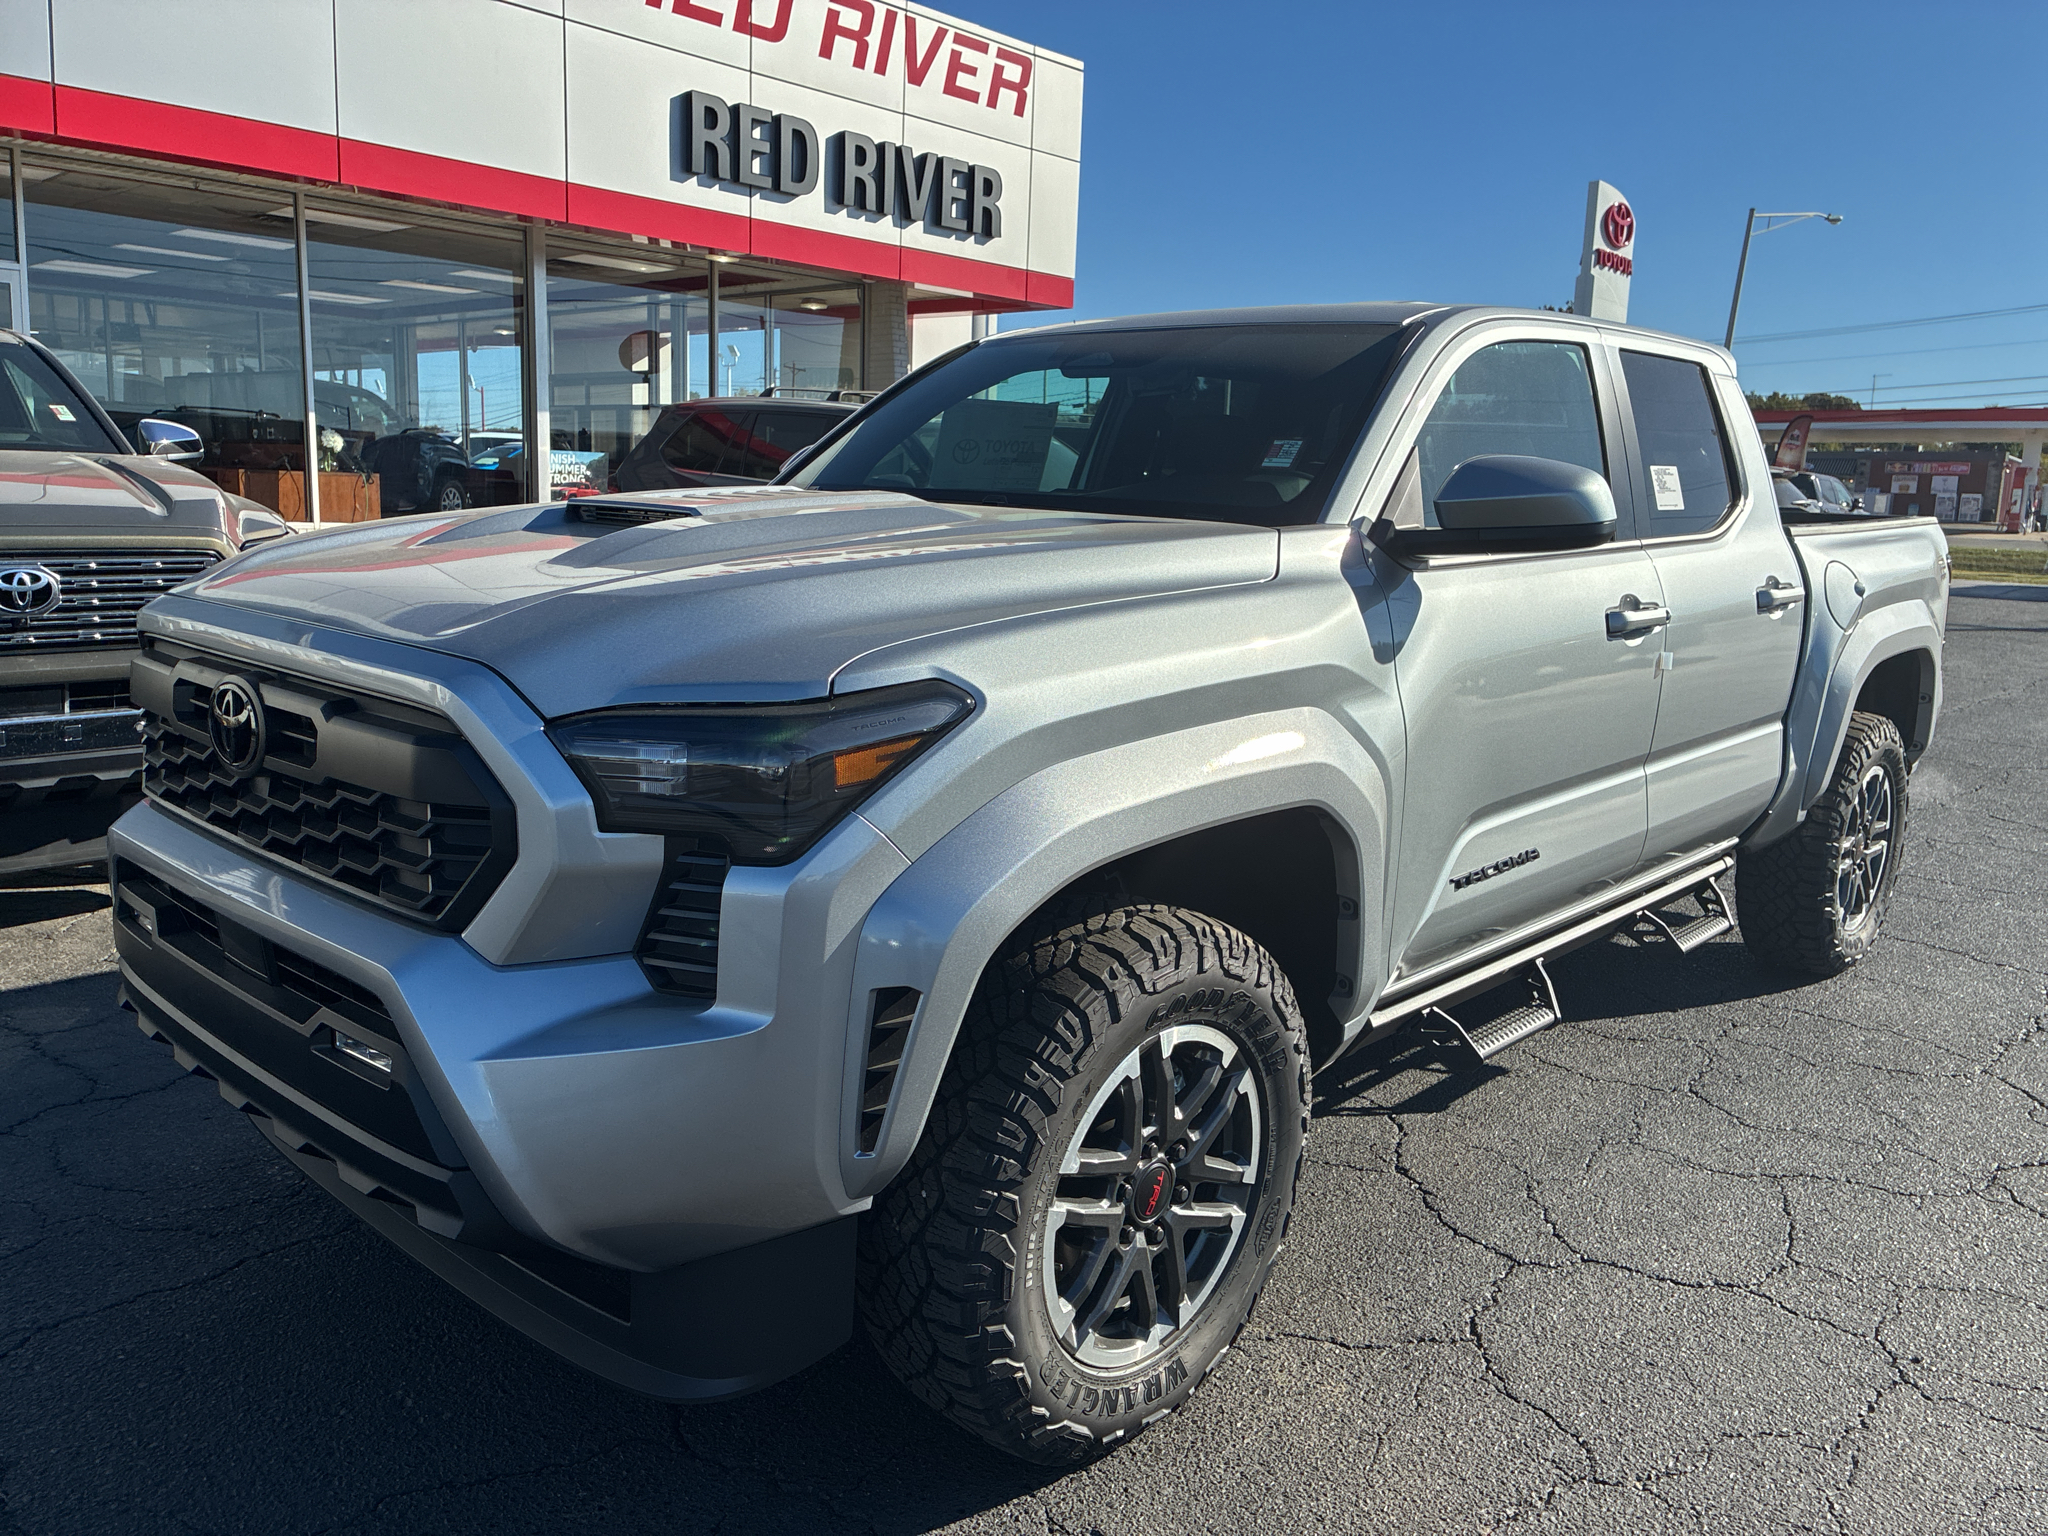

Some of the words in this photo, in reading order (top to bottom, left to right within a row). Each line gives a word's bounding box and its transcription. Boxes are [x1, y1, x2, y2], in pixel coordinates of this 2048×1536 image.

[818, 0, 1033, 118] RIVER
[684, 90, 819, 197] RED
[836, 130, 1002, 238] RIVER
[1596, 248, 1632, 276] TOYOTA
[550, 453, 576, 464] NISH
[985, 438, 1035, 454] TOYOTA
[550, 472, 586, 484] TRONG
[851, 716, 906, 731] TACOMA
[1449, 847, 1540, 892] TACOMA
[1145, 987, 1288, 1077] GOODYEAR
[1025, 1134, 1066, 1289] DURATRAC
[1145, 1171, 1165, 1215] TRD
[1039, 1351, 1190, 1417] WRANGLER
